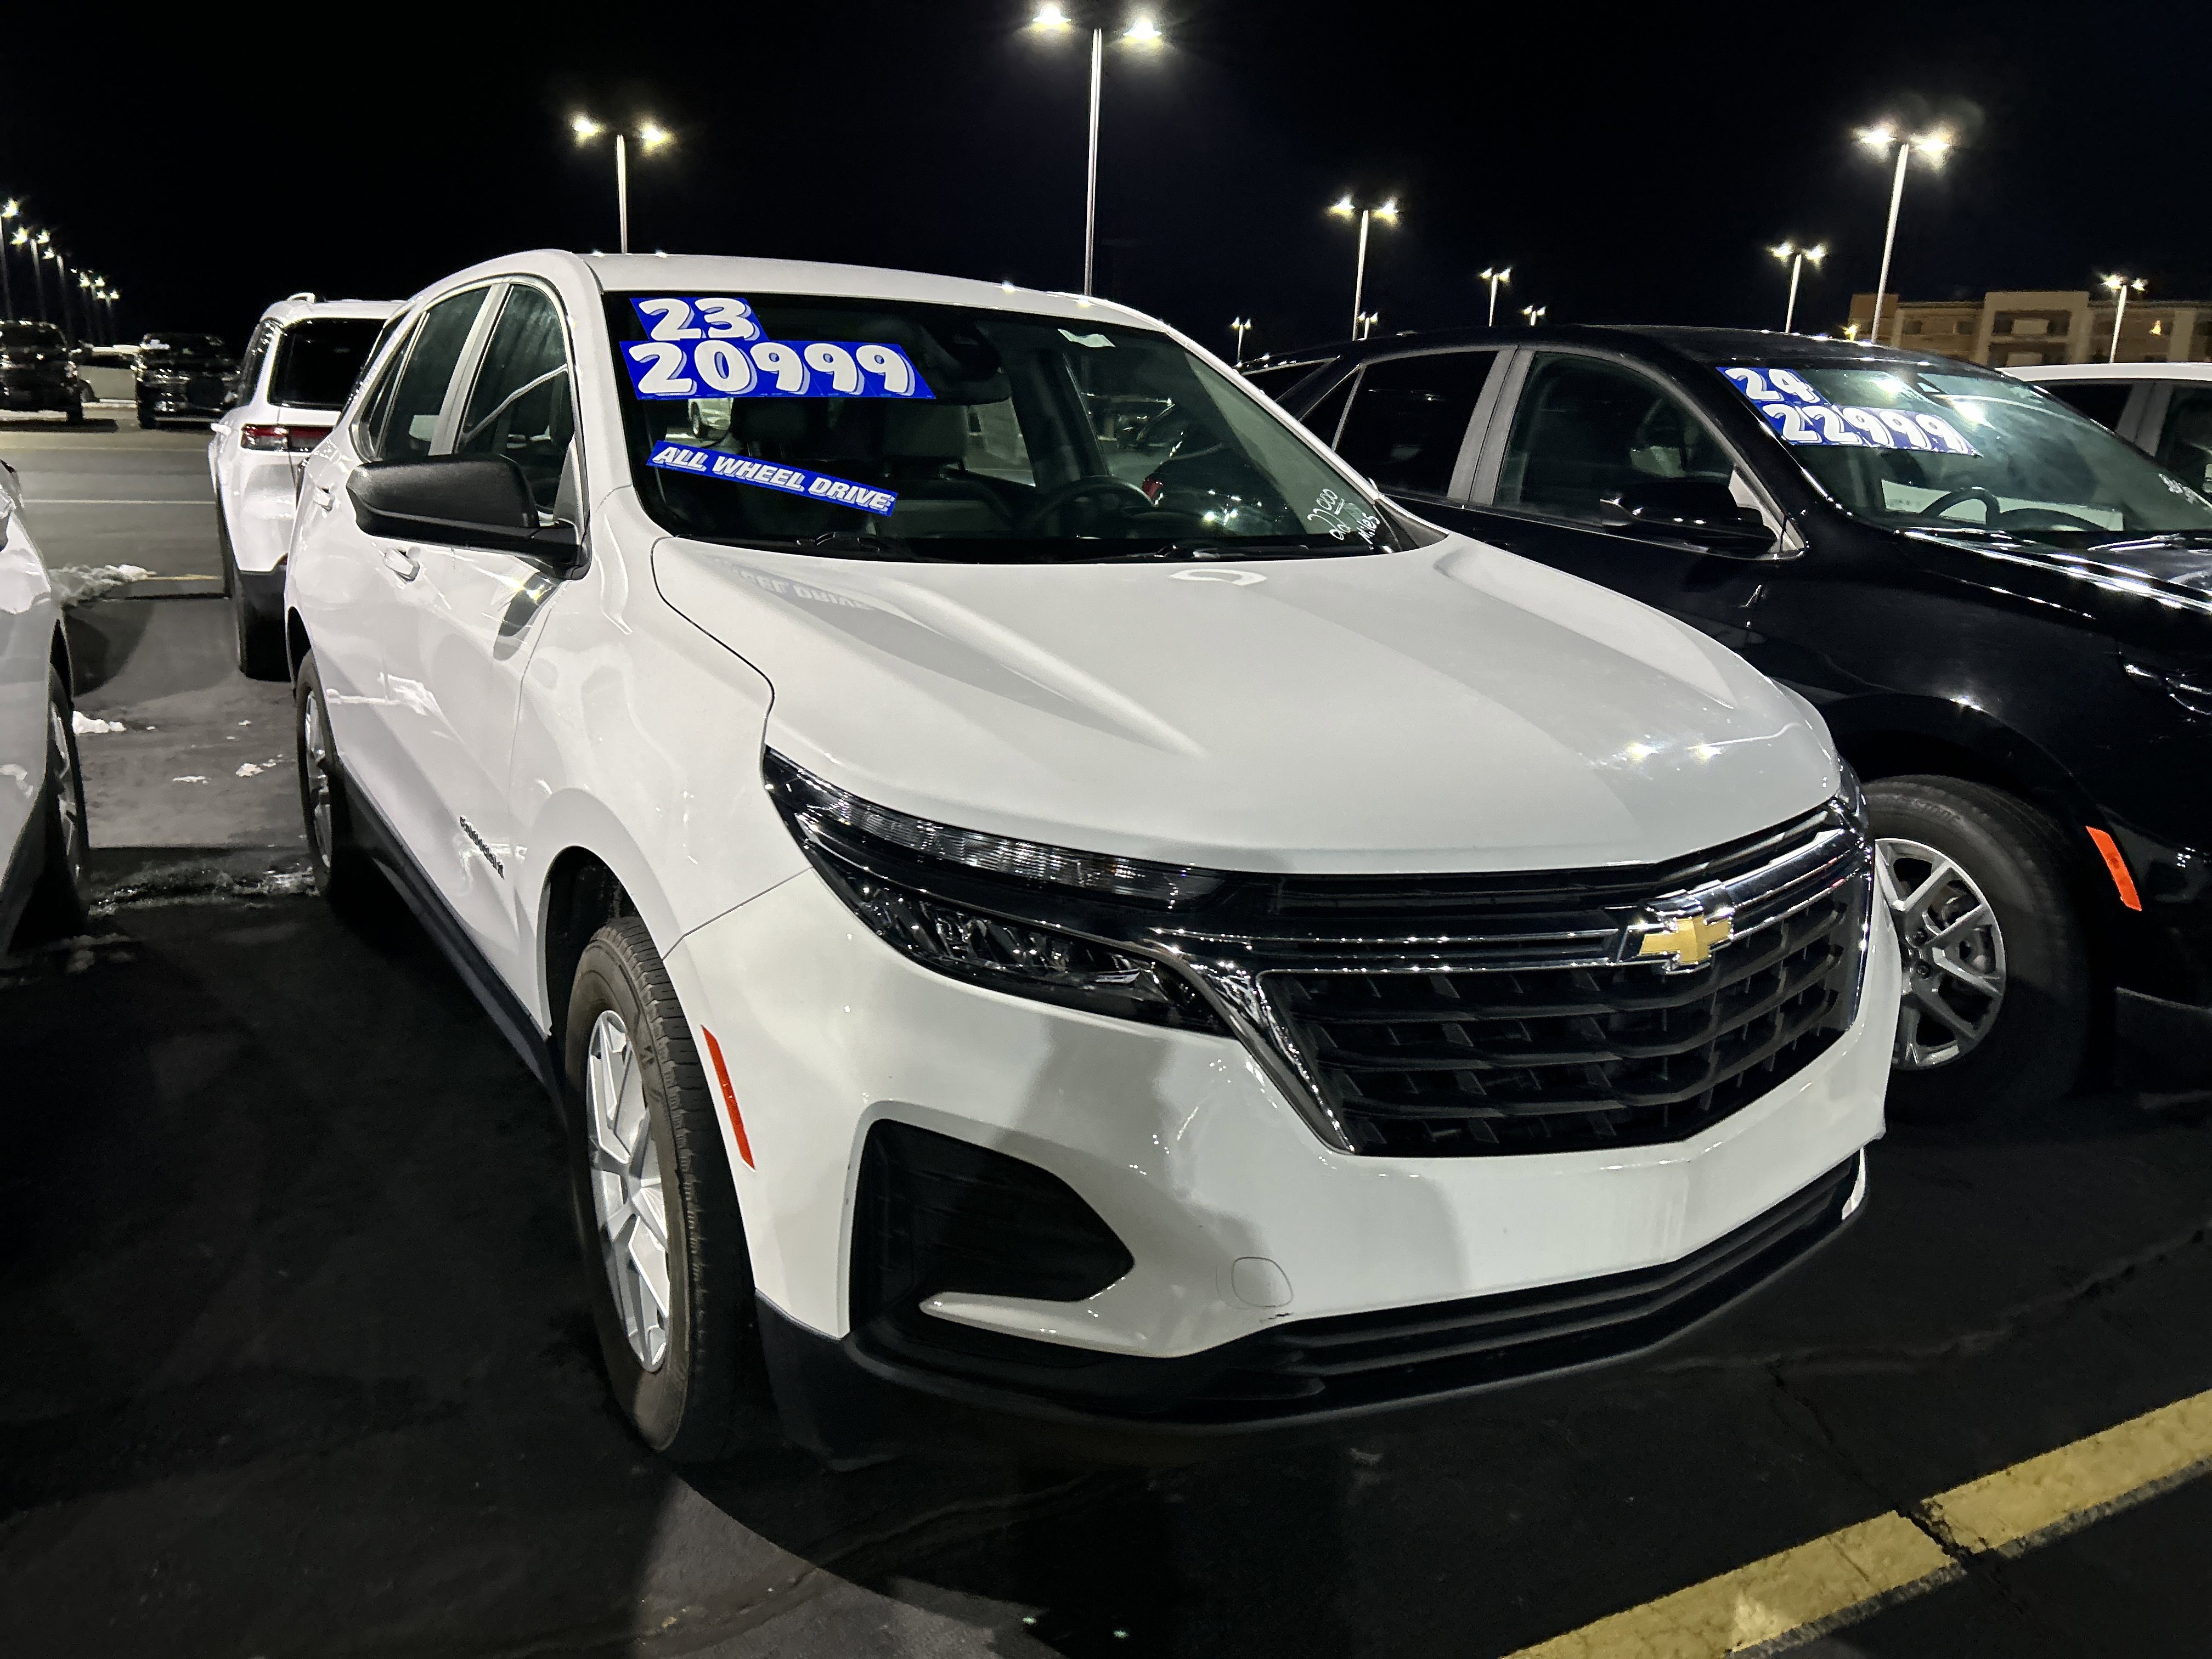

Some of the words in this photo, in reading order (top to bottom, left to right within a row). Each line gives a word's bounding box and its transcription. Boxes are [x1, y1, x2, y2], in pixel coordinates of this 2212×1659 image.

[638, 297, 761, 341] 23
[628, 340, 916, 396] 20999
[1724, 368, 1820, 403] 24
[1762, 403, 1968, 455] 22999
[652, 445, 708, 472] ALL
[713, 455, 805, 492] WHEEL
[808, 477, 895, 512] DRIVE
